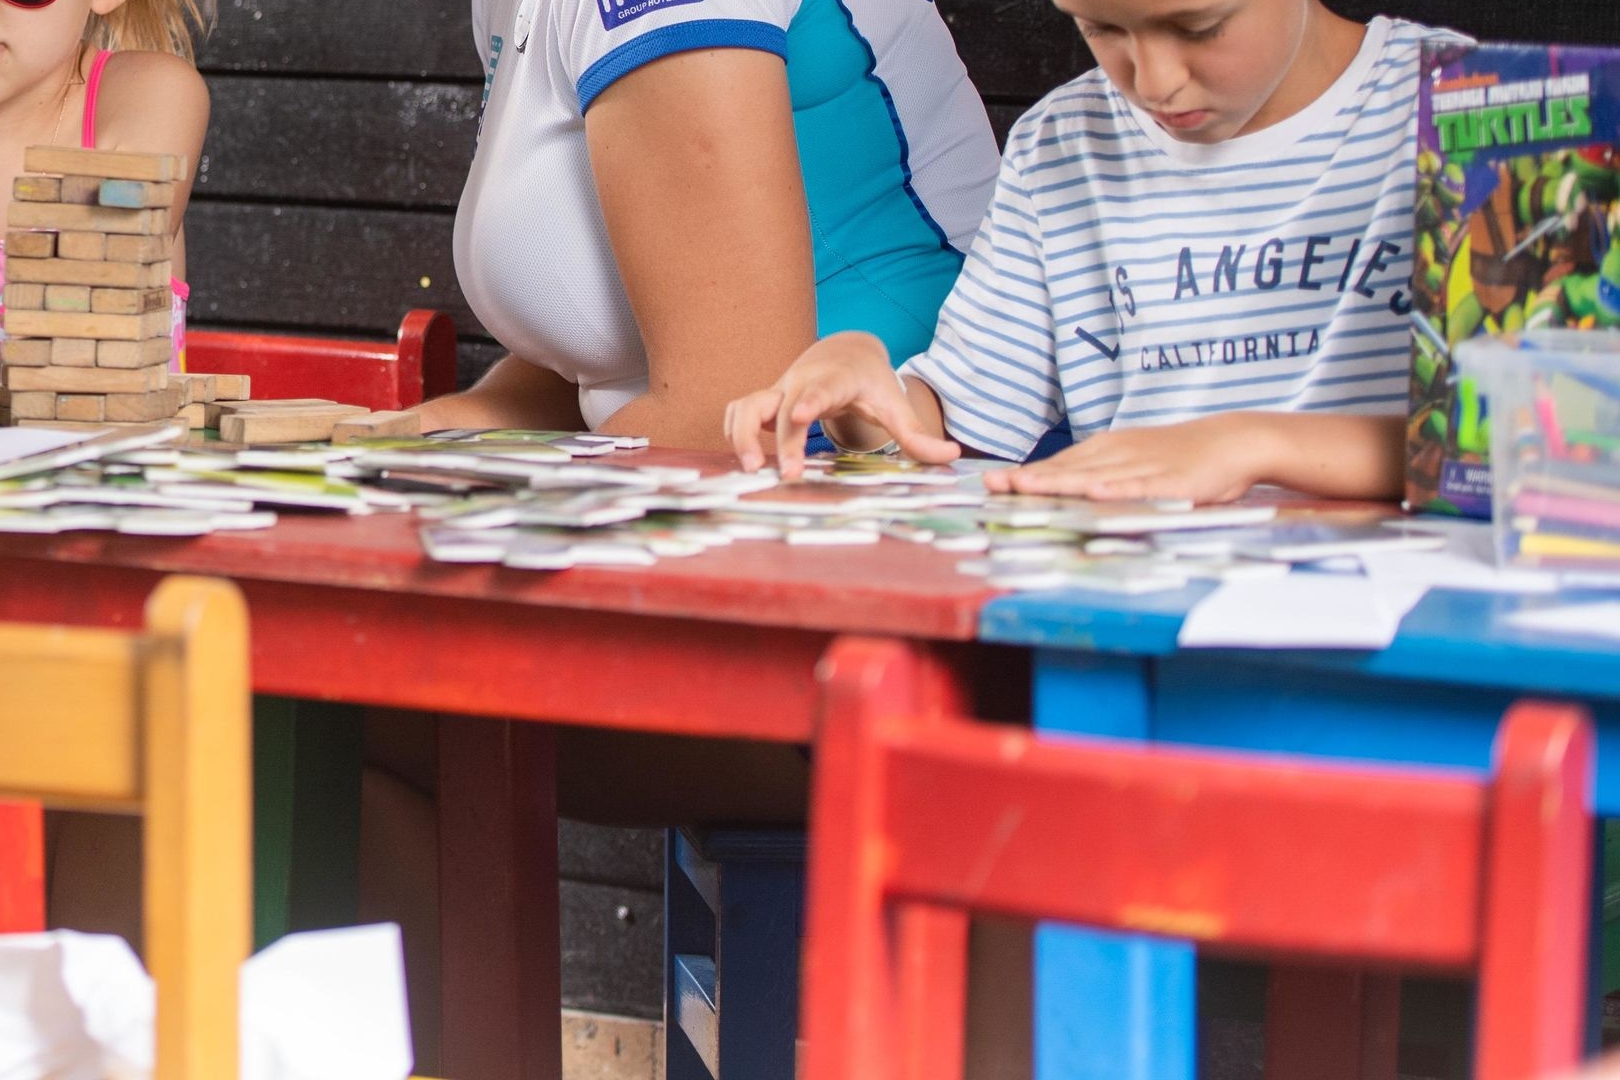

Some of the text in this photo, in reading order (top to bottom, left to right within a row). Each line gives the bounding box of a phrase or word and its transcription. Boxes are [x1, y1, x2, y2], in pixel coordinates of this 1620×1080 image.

[617, 2, 647, 20] GROUP
[1432, 94, 1593, 153] TURTLES
[1074, 265, 1137, 362] LS
[1141, 327, 1321, 372] CALIFORNIA
